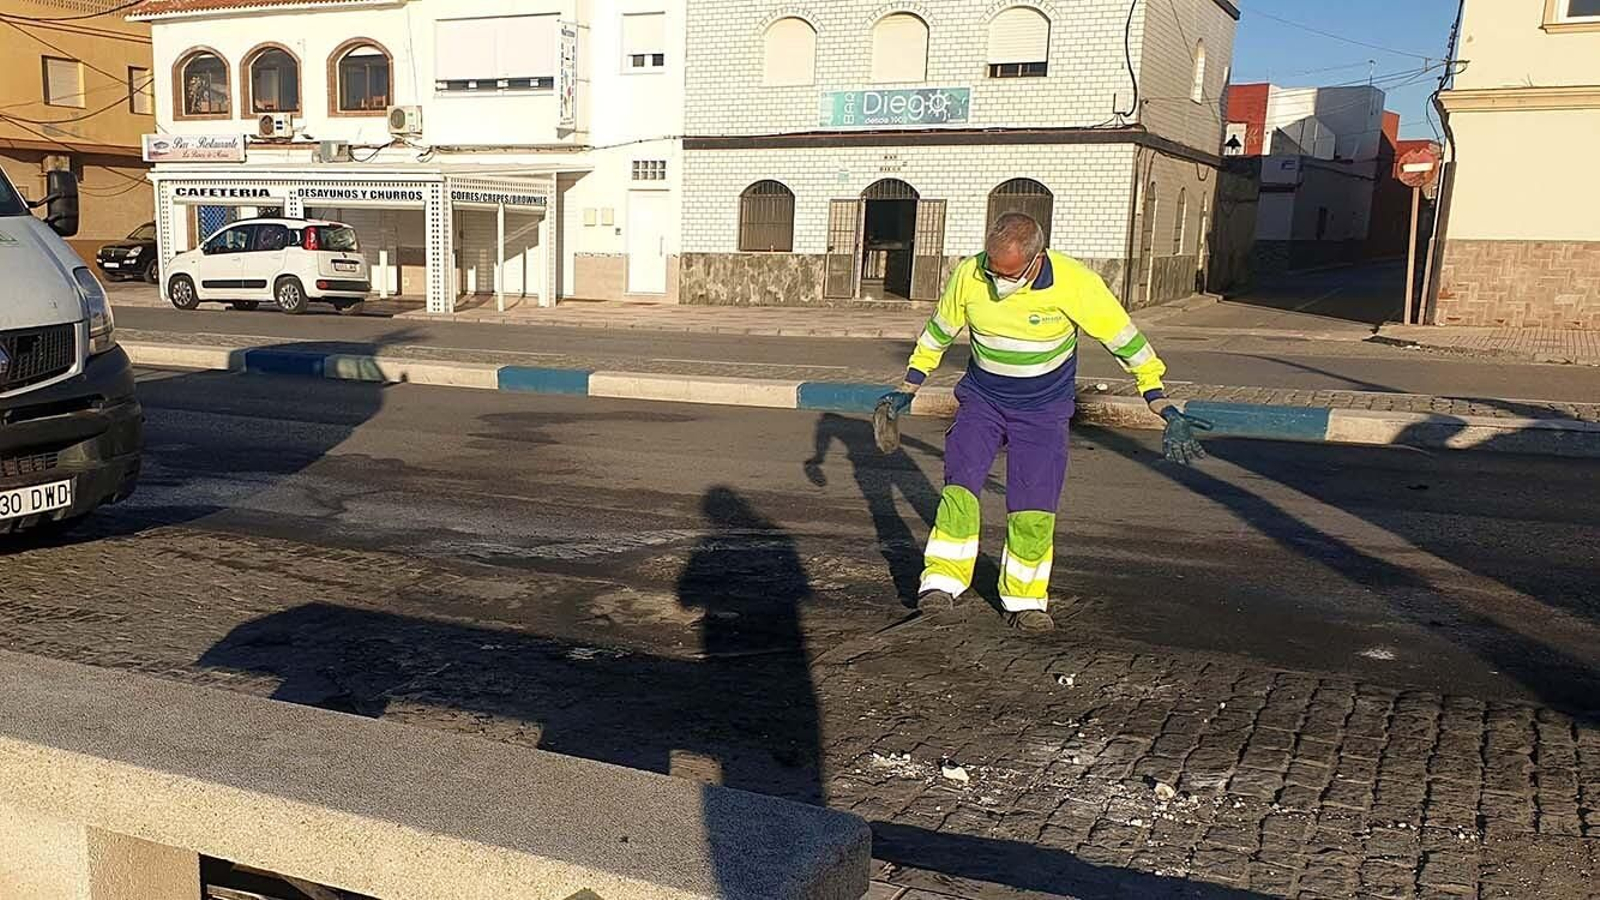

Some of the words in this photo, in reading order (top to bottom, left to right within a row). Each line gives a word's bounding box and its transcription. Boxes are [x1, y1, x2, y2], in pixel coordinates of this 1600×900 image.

[844, 92, 855, 124] BAR
[863, 89, 951, 121] Diego
[172, 136, 189, 149] Bar
[196, 136, 238, 149] Restaurante
[175, 187, 271, 197] CAFETERIA
[297, 188, 358, 199] DESAYUNOS
[359, 190, 368, 199] Y
[369, 190, 423, 200] CHURROS
[31, 484, 68, 510] DWD
